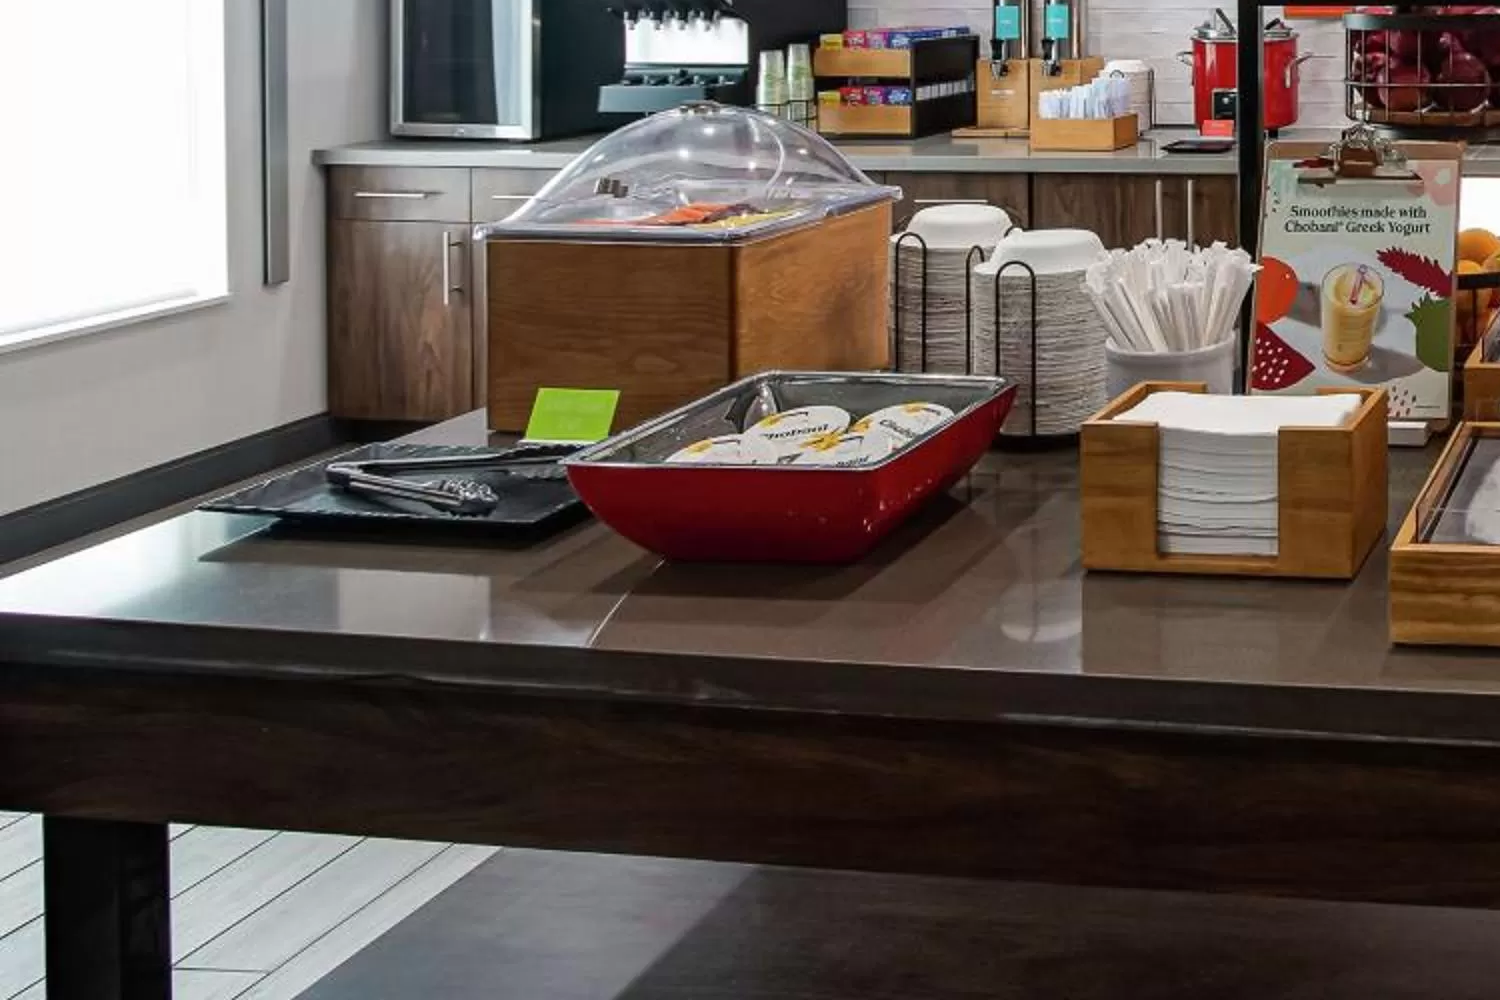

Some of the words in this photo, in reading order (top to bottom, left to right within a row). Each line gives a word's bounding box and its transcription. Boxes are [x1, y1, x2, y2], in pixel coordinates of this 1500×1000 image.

[1290, 205, 1358, 219] Smoothies
[1361, 205, 1396, 219] made
[1399, 205, 1427, 219] with
[1346, 220, 1386, 234] Greek
[1387, 221, 1431, 236] Yogurt
